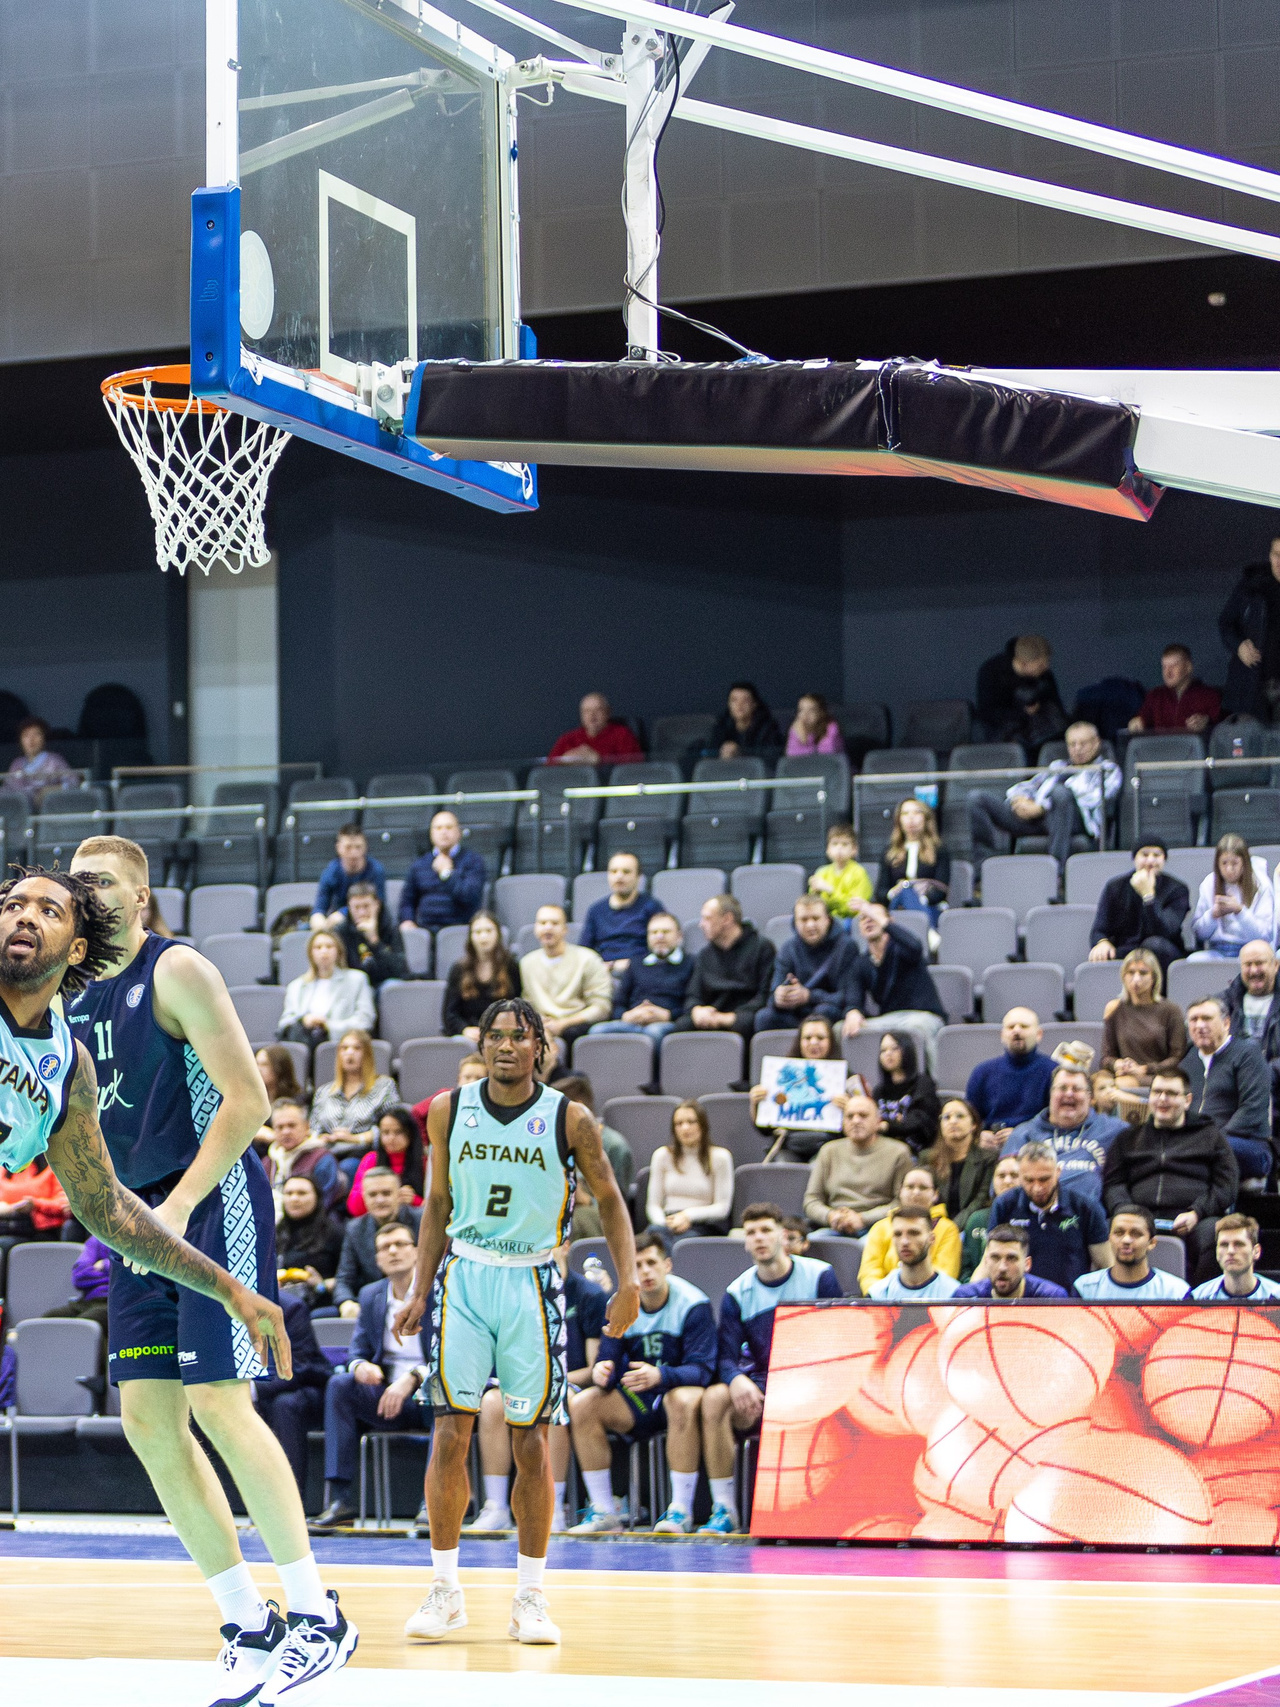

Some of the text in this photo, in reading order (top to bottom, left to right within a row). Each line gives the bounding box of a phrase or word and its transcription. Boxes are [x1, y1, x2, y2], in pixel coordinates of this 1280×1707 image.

[94, 1020, 114, 1061] 11
[458, 1141, 546, 1171] ASTANA
[485, 1184, 513, 1217] 2
[119, 1345, 175, 1359] евроопт
[642, 1333, 664, 1358] 15
